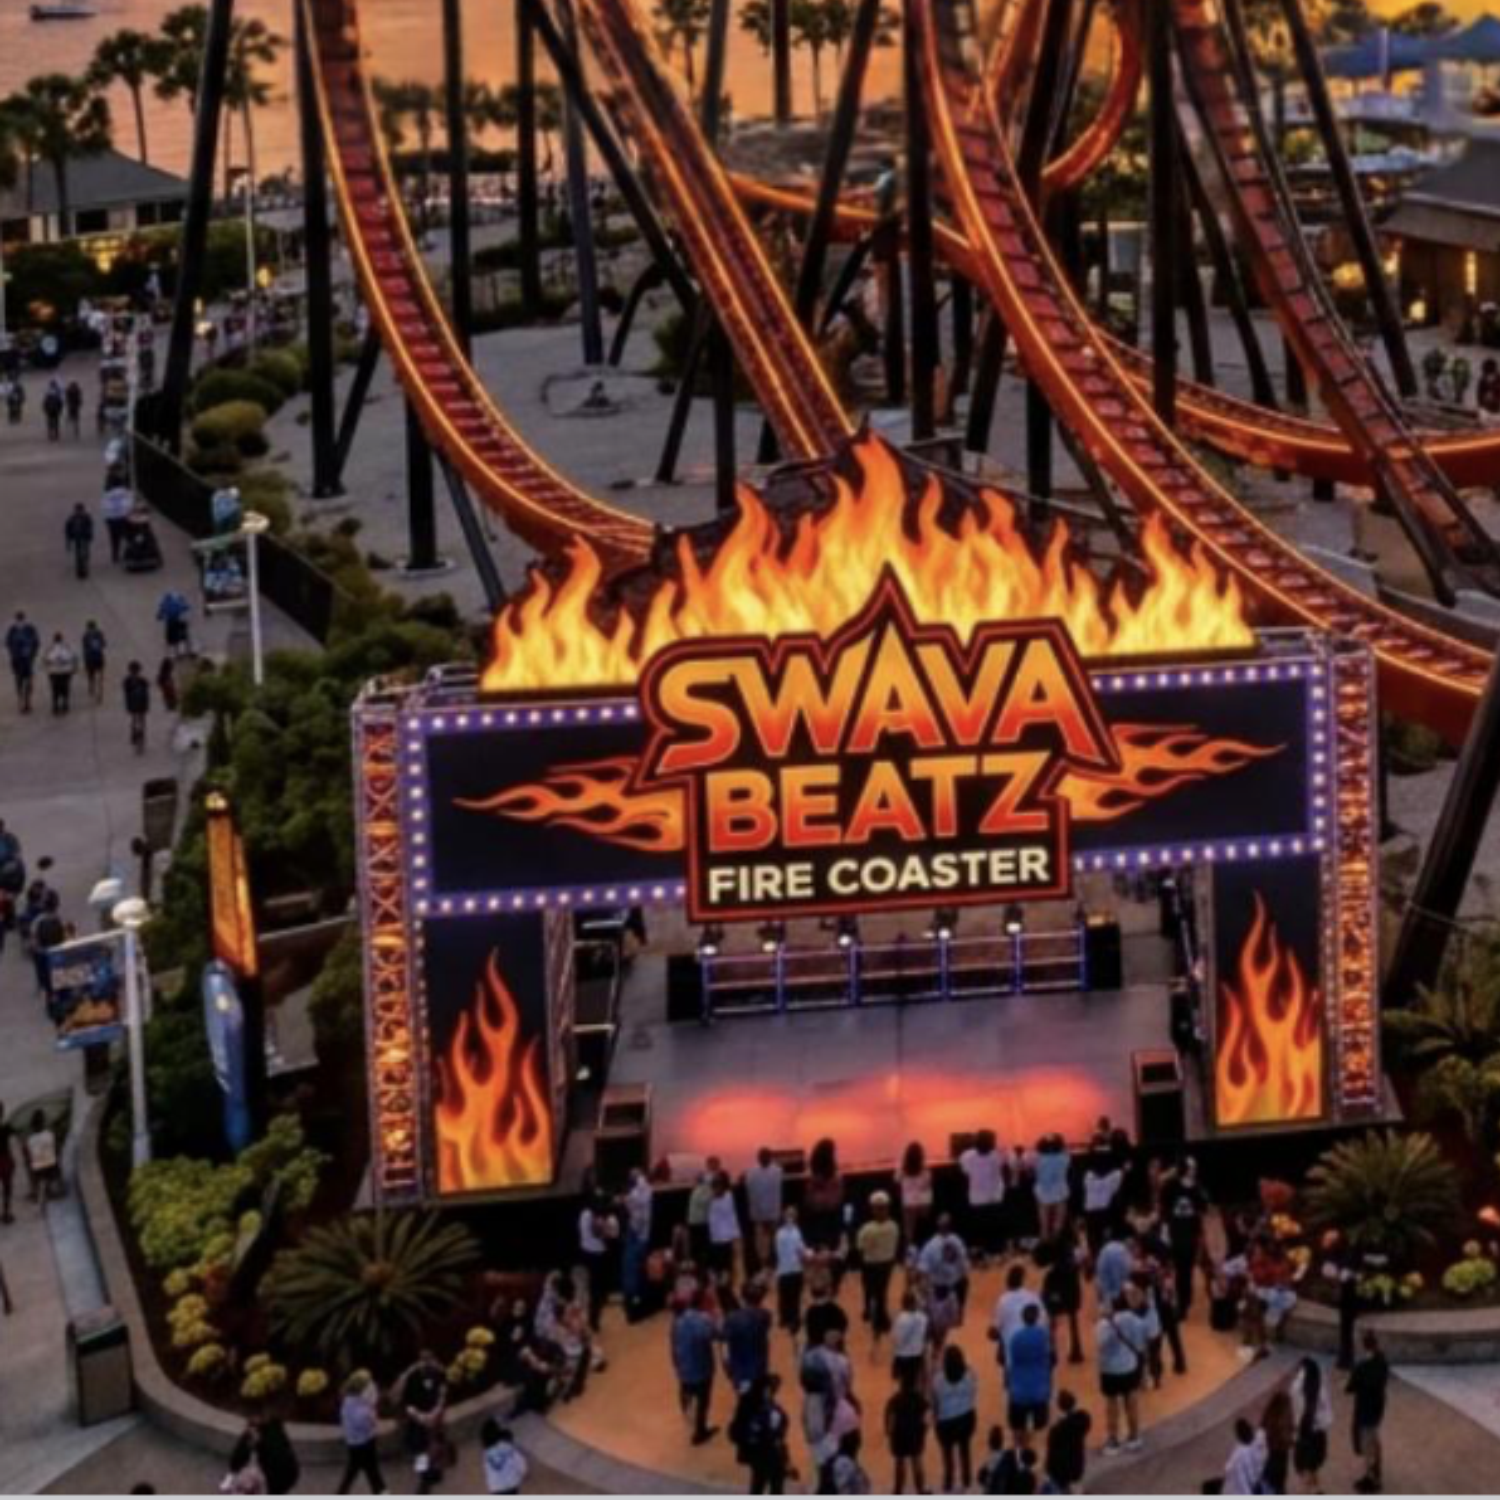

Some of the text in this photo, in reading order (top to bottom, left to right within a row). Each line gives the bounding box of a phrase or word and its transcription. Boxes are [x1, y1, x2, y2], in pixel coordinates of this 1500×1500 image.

[657, 623, 1107, 773] SWAVA
[706, 751, 1052, 852] BEATZ
[708, 847, 1050, 903] FIRE COASTER
